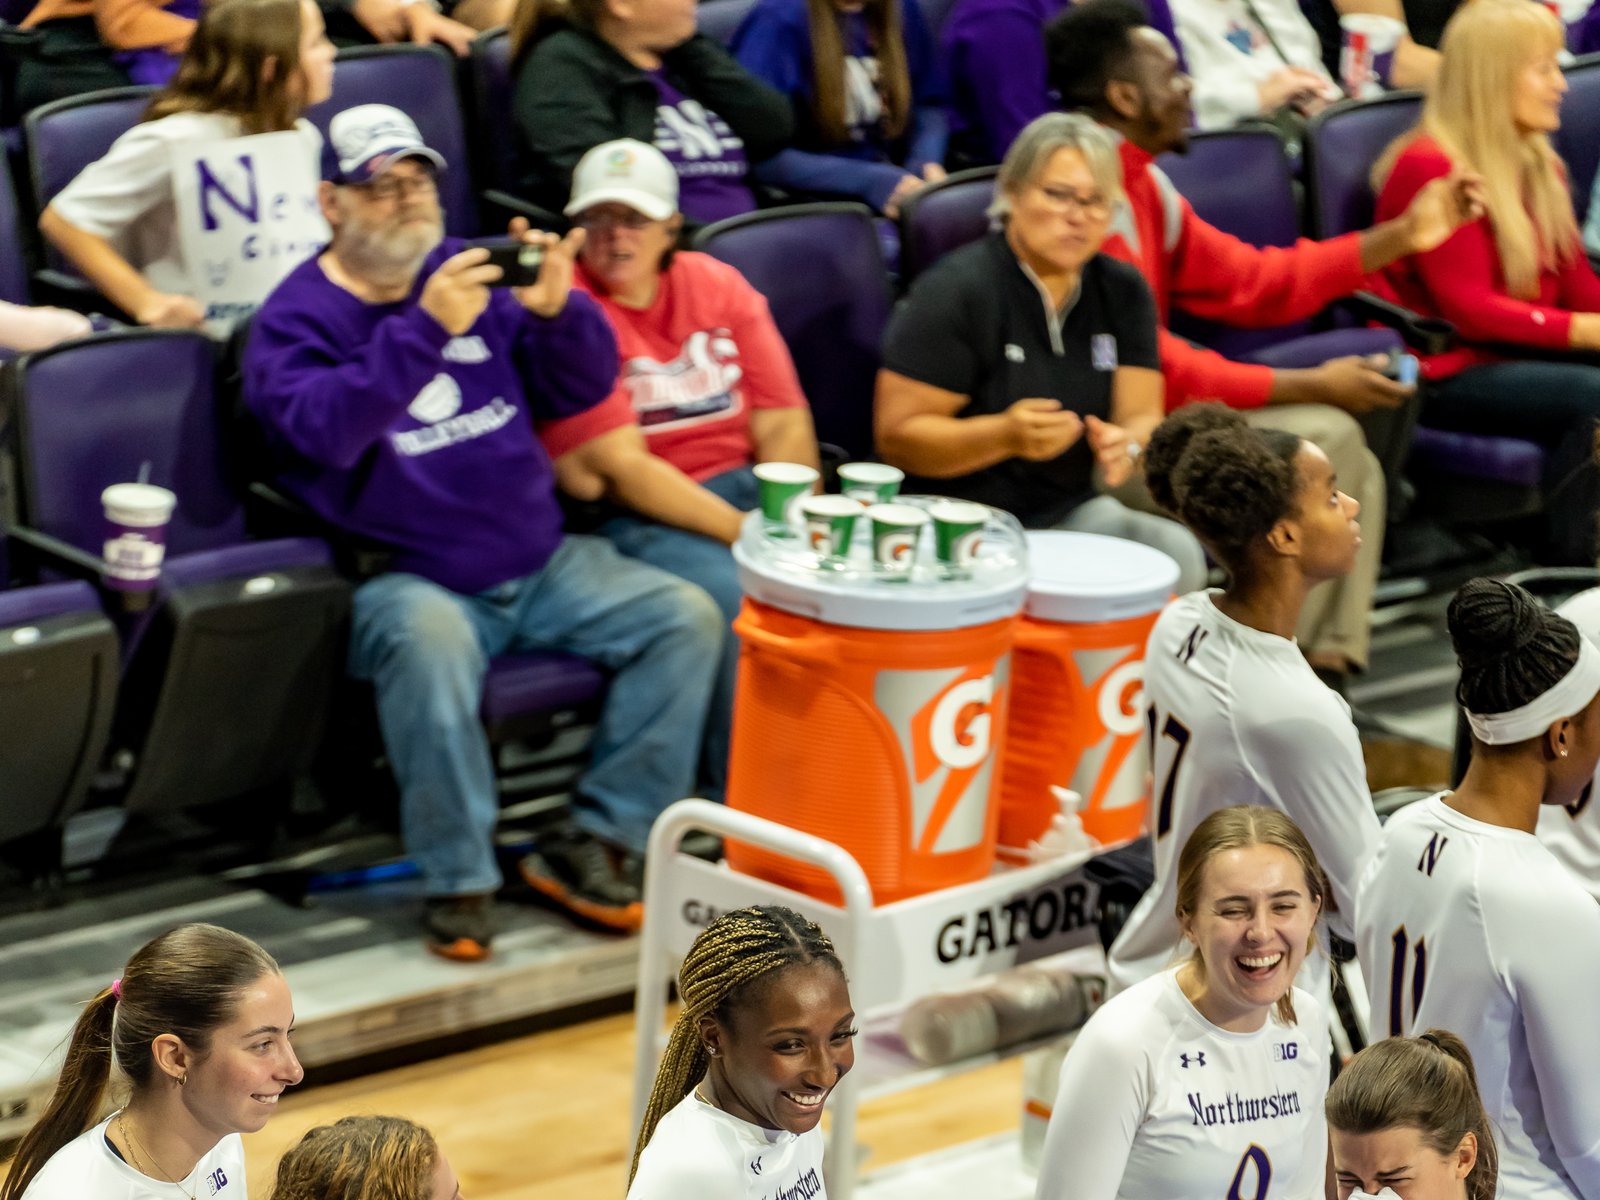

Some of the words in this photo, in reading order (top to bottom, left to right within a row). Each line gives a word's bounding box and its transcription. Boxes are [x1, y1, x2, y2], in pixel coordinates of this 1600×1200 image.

[880, 531, 918, 573] G
[929, 674, 994, 770] G
[1097, 659, 1146, 736] G
[1416, 832, 1448, 877] N
[936, 883, 1102, 964] GATOR
[1389, 922, 1428, 1036] 11
[1187, 1085, 1301, 1127] Northwestern
